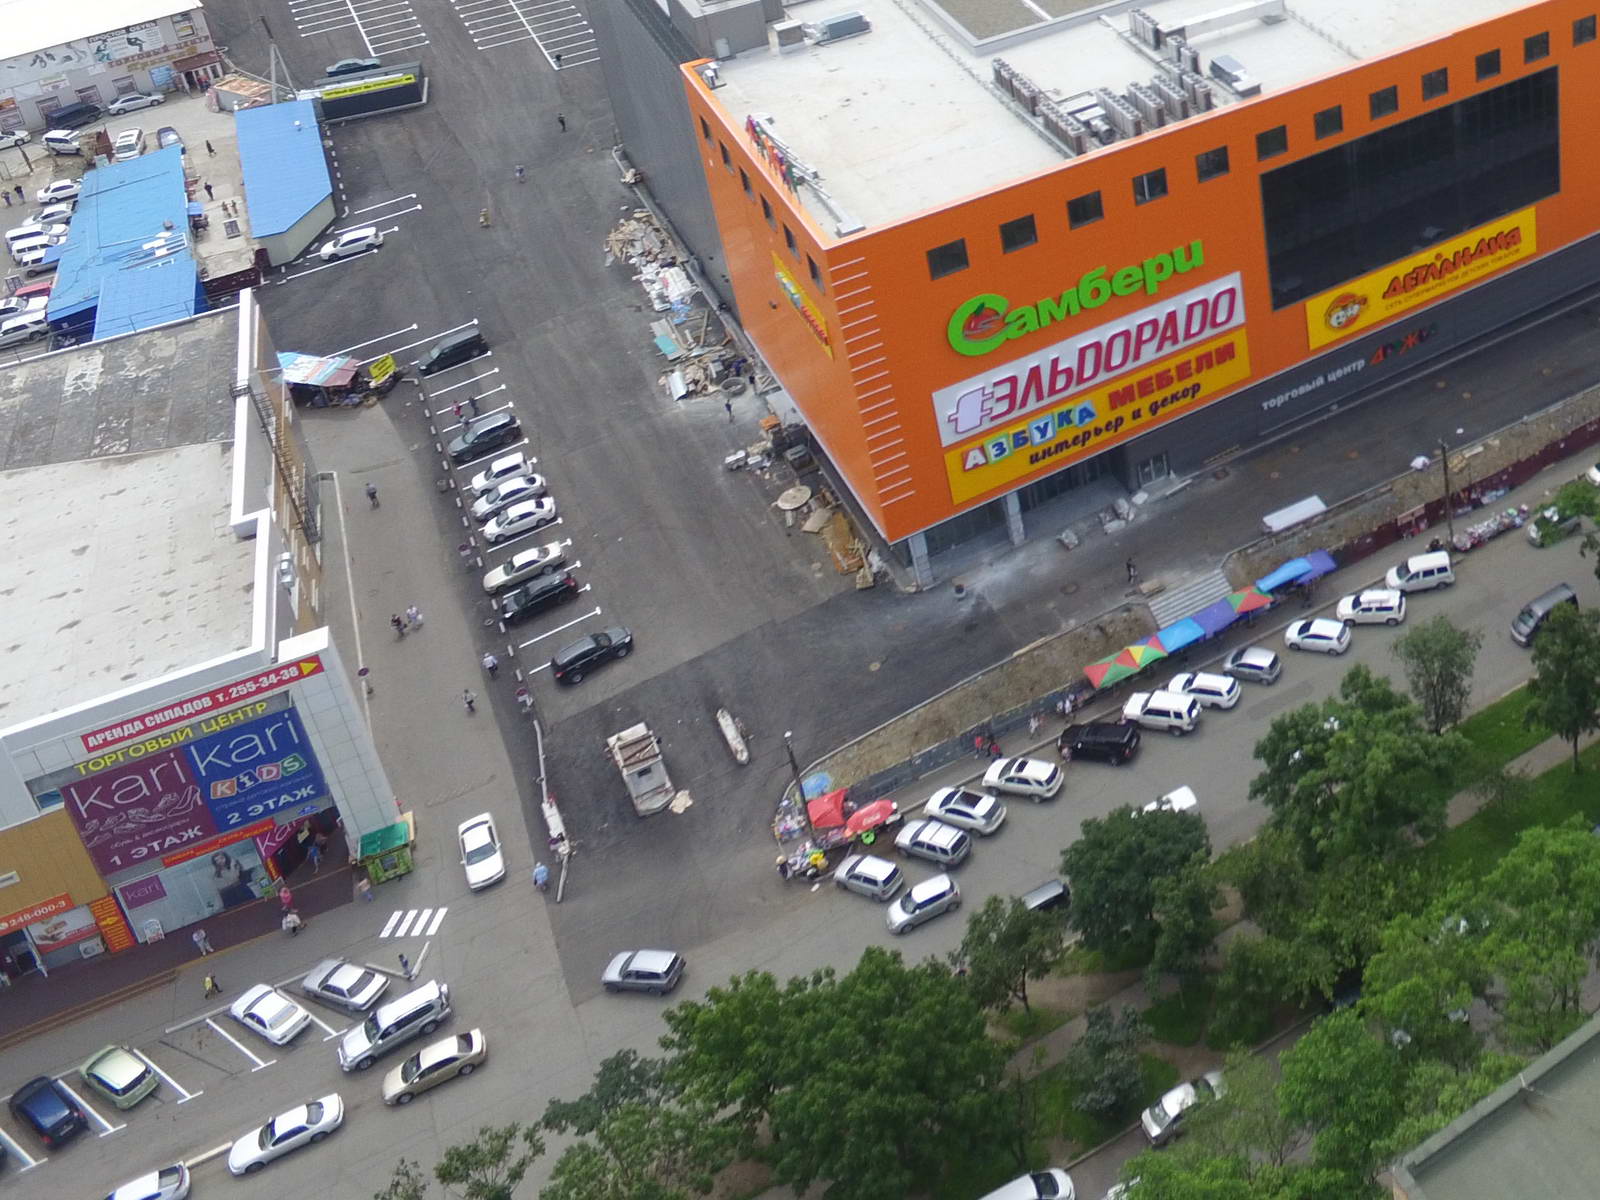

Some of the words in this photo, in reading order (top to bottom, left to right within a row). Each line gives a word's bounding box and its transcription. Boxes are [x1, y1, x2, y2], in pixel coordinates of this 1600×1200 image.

[1382, 226, 1522, 300] ДЕТЛАНДИЯ
[947, 240, 1204, 356] Самбери
[963, 401, 1097, 472] АЗБУКА
[1108, 342, 1236, 410] МЕБЕЛИ
[1262, 374, 1325, 411] торговый
[1327, 358, 1367, 383] центр
[1028, 415, 1125, 466] интерьер
[1131, 404, 1144, 422] и
[1149, 380, 1202, 417] декор
[73, 725, 194, 776] ТОРГОВЫЙ
[200, 701, 268, 735] ЦЕНТР
[87, 721, 145, 748] АРЕНДА
[144, 696, 213, 728] СКЛАДОВ
[189, 712, 300, 777] kari
[70, 752, 186, 819] kari
[226, 812, 243, 825] 2
[247, 784, 317, 817] ЭТАЖ
[110, 855, 122, 866] 1
[130, 825, 204, 859] ЭТАЖ
